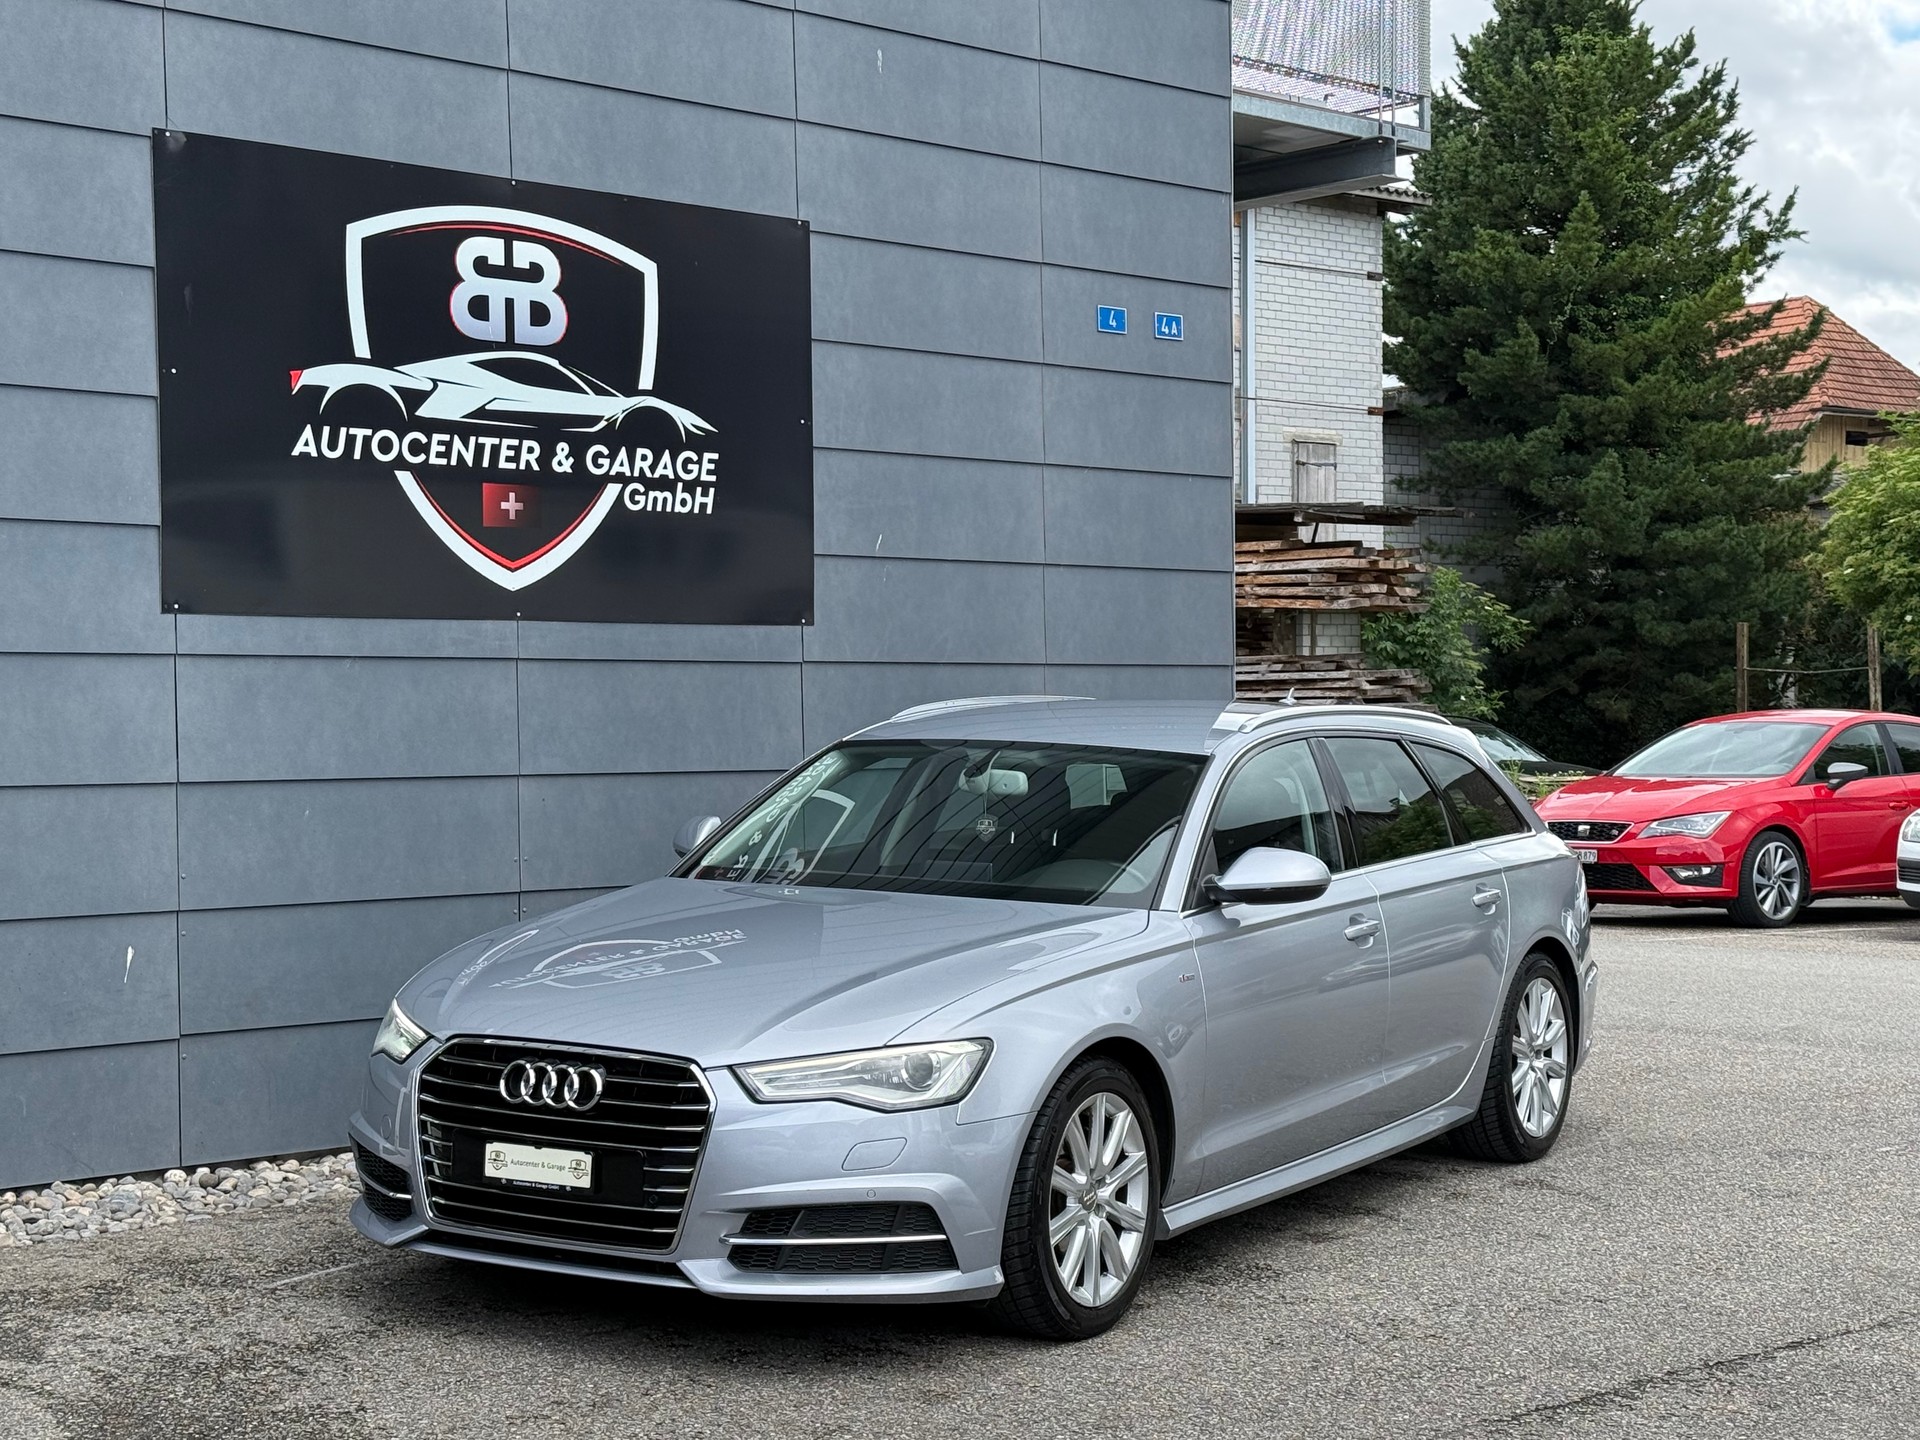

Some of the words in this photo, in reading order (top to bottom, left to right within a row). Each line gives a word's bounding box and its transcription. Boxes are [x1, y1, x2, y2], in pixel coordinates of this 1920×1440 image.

[1109, 310, 1117, 328] 4
[1161, 317, 1178, 336] 4A
[291, 424, 540, 471] AUTOCENTER
[551, 441, 575, 474] &
[585, 448, 719, 482] GARAGE
[623, 483, 715, 515] GmbH
[510, 1158, 540, 1168] Autocenter
[547, 1162, 566, 1172] Garage
